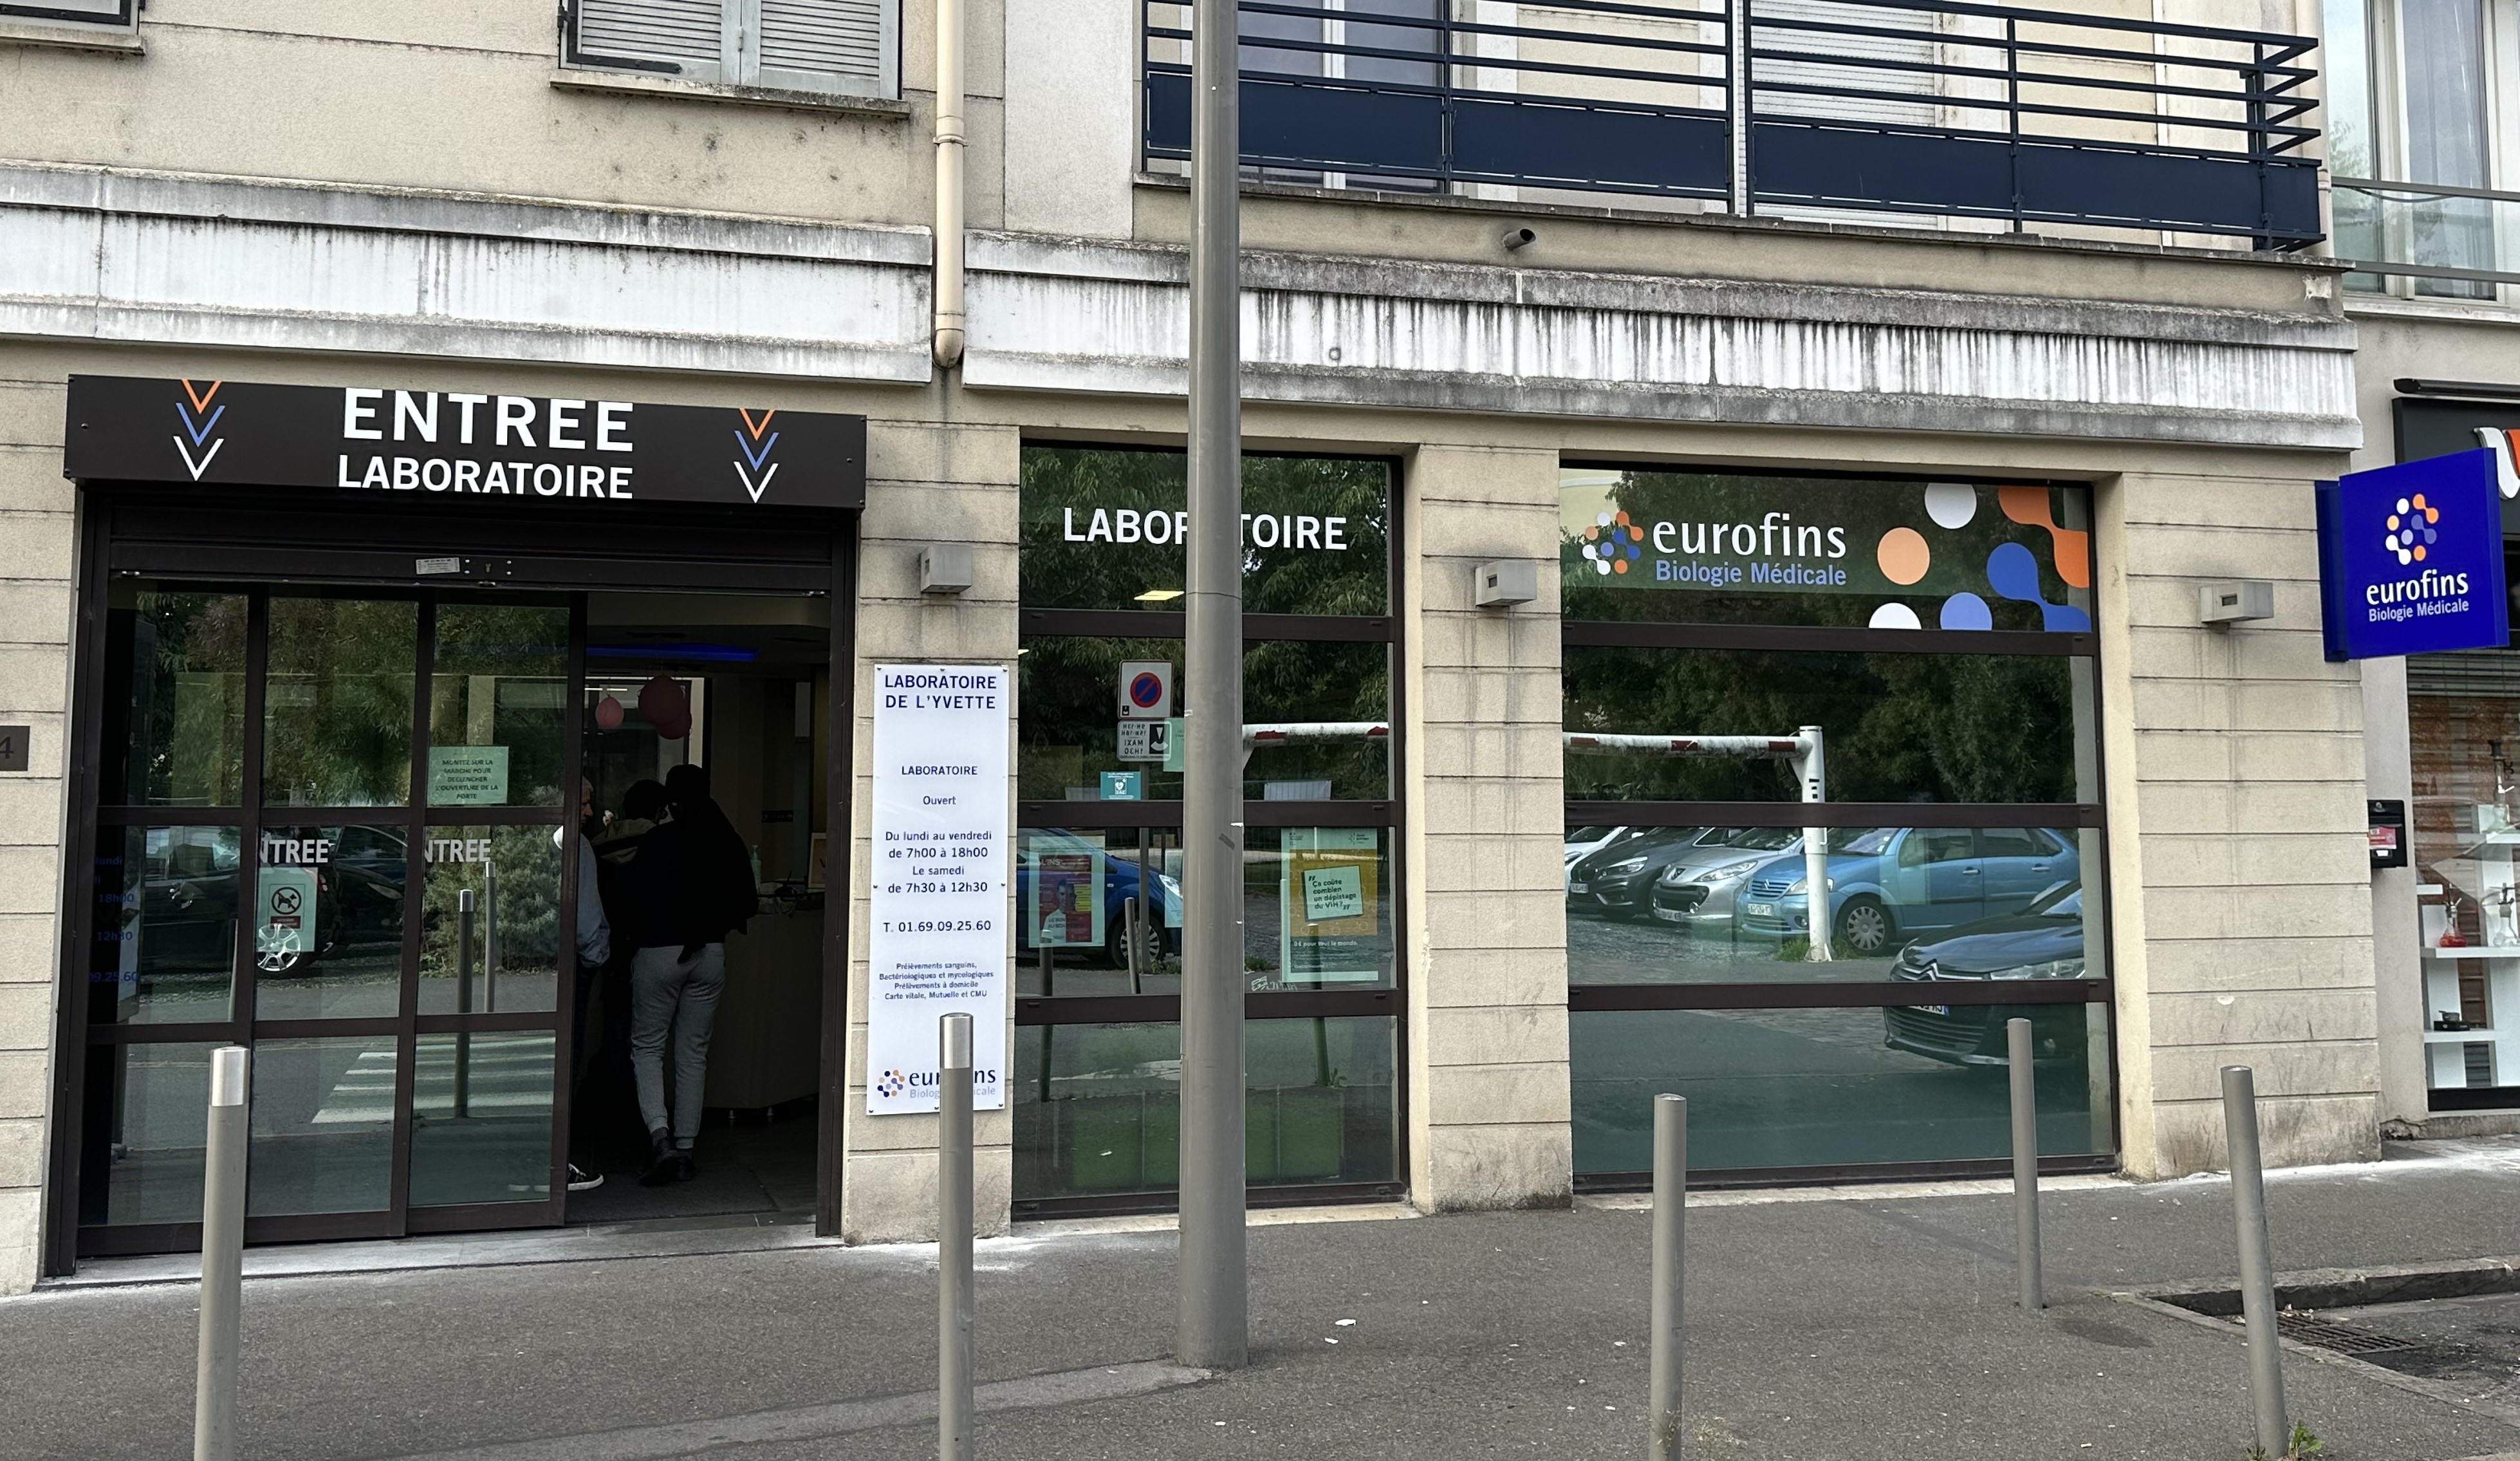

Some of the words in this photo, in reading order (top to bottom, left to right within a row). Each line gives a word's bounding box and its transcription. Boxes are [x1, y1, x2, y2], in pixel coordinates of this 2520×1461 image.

[343, 387, 634, 452] ENTREE
[337, 454, 633, 499] LABORATOIRE
[1653, 512, 1847, 559] eurofins
[1656, 560, 1742, 587] Biologie
[1751, 563, 1847, 586] Médicale
[2366, 569, 2469, 606] eurofins
[2369, 604, 2413, 622] Biologie
[2416, 598, 2469, 617] Médicale
[885, 675, 997, 689] LABORATOIRE
[885, 695, 908, 709] DE
[916, 695, 996, 709] L'YVETTE
[901, 766, 978, 776] LABORATOIRE
[922, 796, 957, 805] Ouvert
[885, 831, 900, 841] Du
[903, 831, 929, 841] lundi
[932, 832, 945, 841] au
[949, 830, 992, 840] vendredi
[889, 848, 902, 858] de
[906, 848, 936, 858] 7h00
[940, 847, 947, 858] à
[951, 847, 988, 857] 18h00
[912, 866, 925, 875] Le
[928, 865, 965, 875] samedi
[888, 884, 902, 893] de
[905, 882, 936, 893] 7h30
[940, 882, 946, 893] à
[950, 882, 988, 892] 12h30
[1313, 886, 1342, 895] combien
[1324, 893, 1357, 902] dépistage
[883, 922, 894, 933] T.
[898, 920, 992, 932] 01.69.09.25.60
[947, 971, 994, 980] mycologiques
[905, 992, 927, 1000] vitale,
